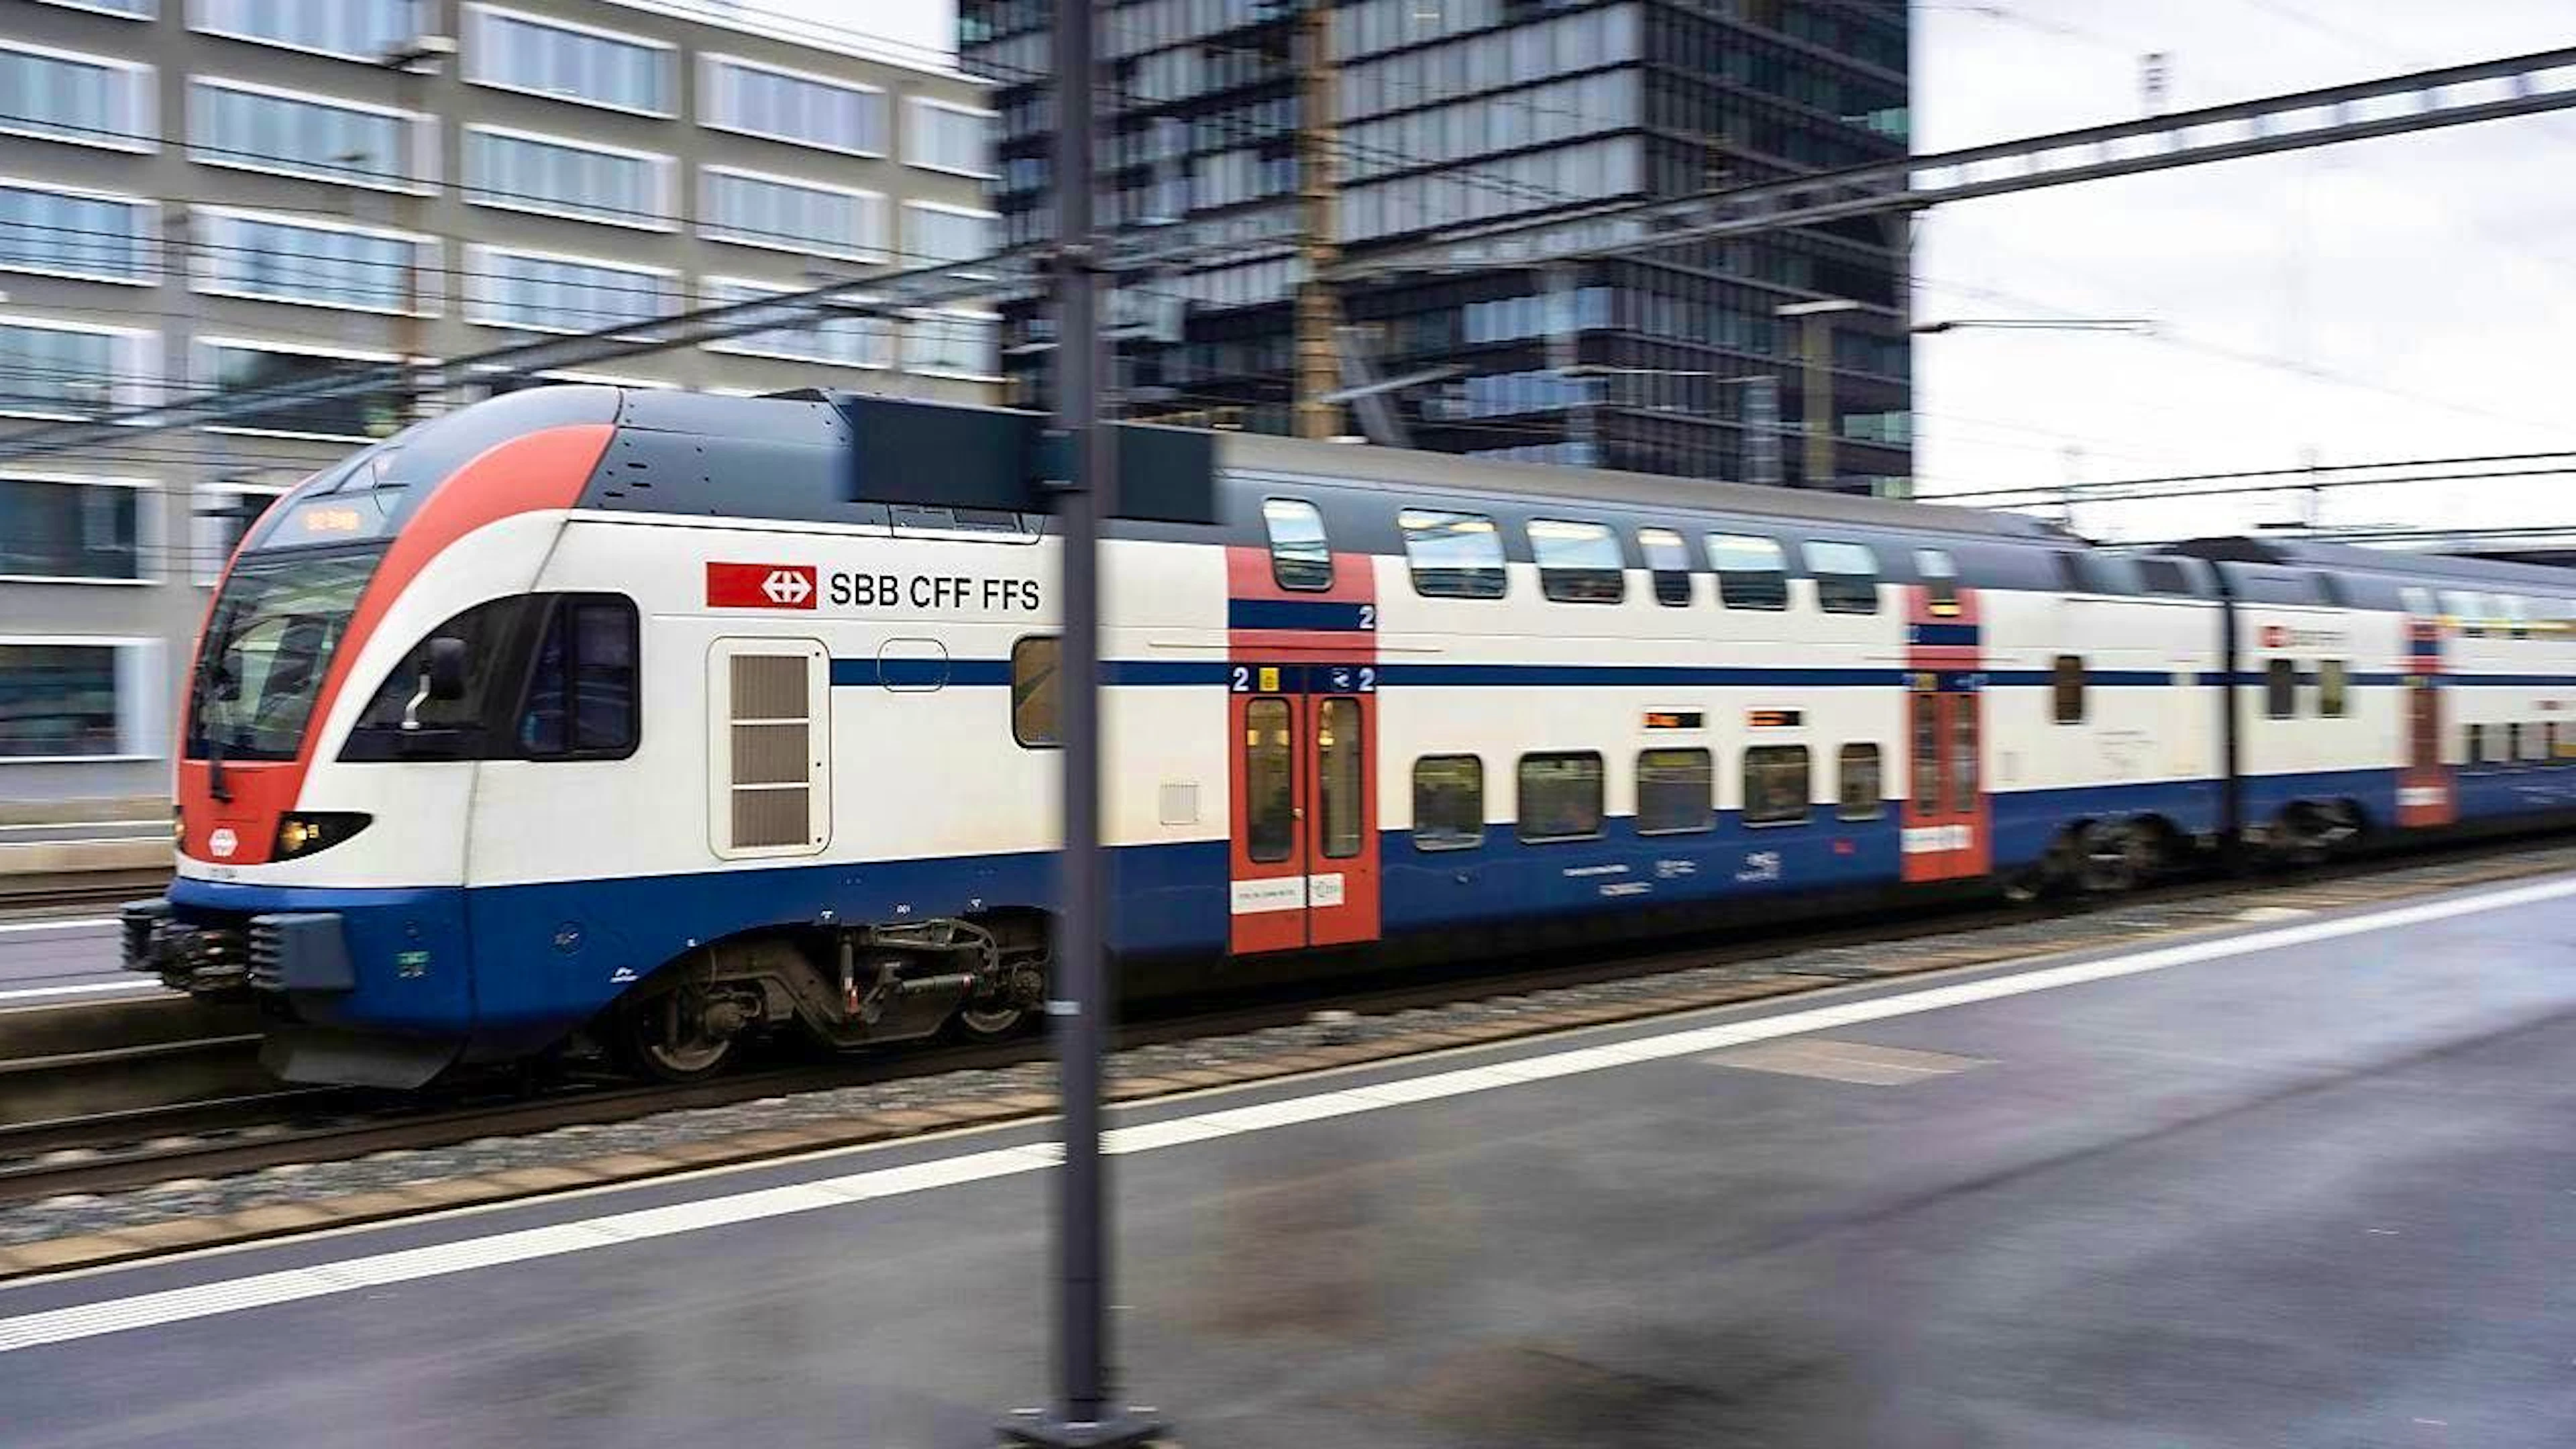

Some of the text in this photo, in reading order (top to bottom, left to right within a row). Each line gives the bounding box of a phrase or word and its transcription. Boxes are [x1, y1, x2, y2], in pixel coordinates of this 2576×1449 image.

[831, 573, 1039, 610] SBB CFF FFS
[1358, 605, 1375, 629] 2
[1232, 666, 1250, 692] 2
[1358, 667, 1375, 692] 2
